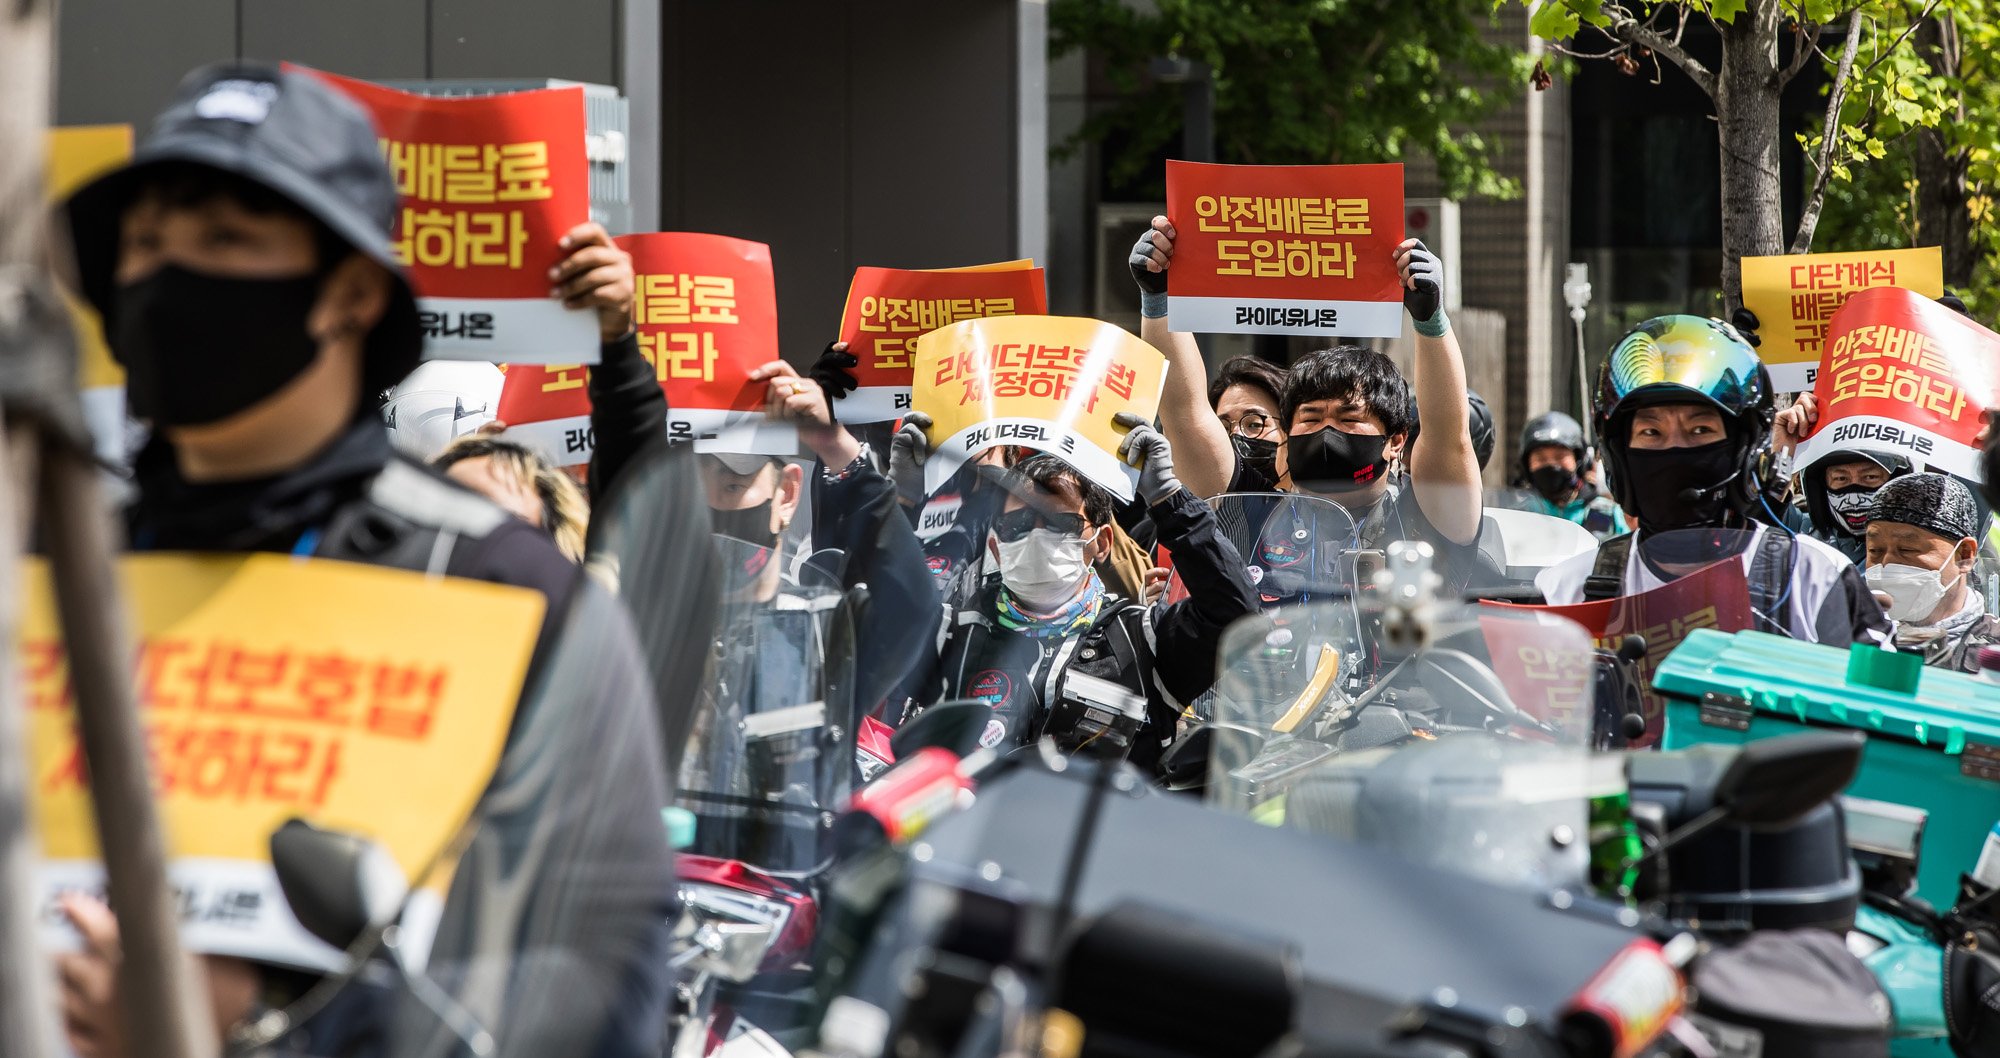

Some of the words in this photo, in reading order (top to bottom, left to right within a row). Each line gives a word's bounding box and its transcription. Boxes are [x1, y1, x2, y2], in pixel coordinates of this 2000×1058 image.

[1195, 195, 1372, 235] 안전배달료
[1216, 239, 1357, 279] 도입하라
[1790, 260, 1896, 290] 다단계식
[1235, 306, 1337, 328] 라이더유니온
[1829, 363, 1967, 422] 도입하라
[965, 424, 1075, 455] 라이더유니온
[1832, 422, 1934, 456] 라이더유니온
